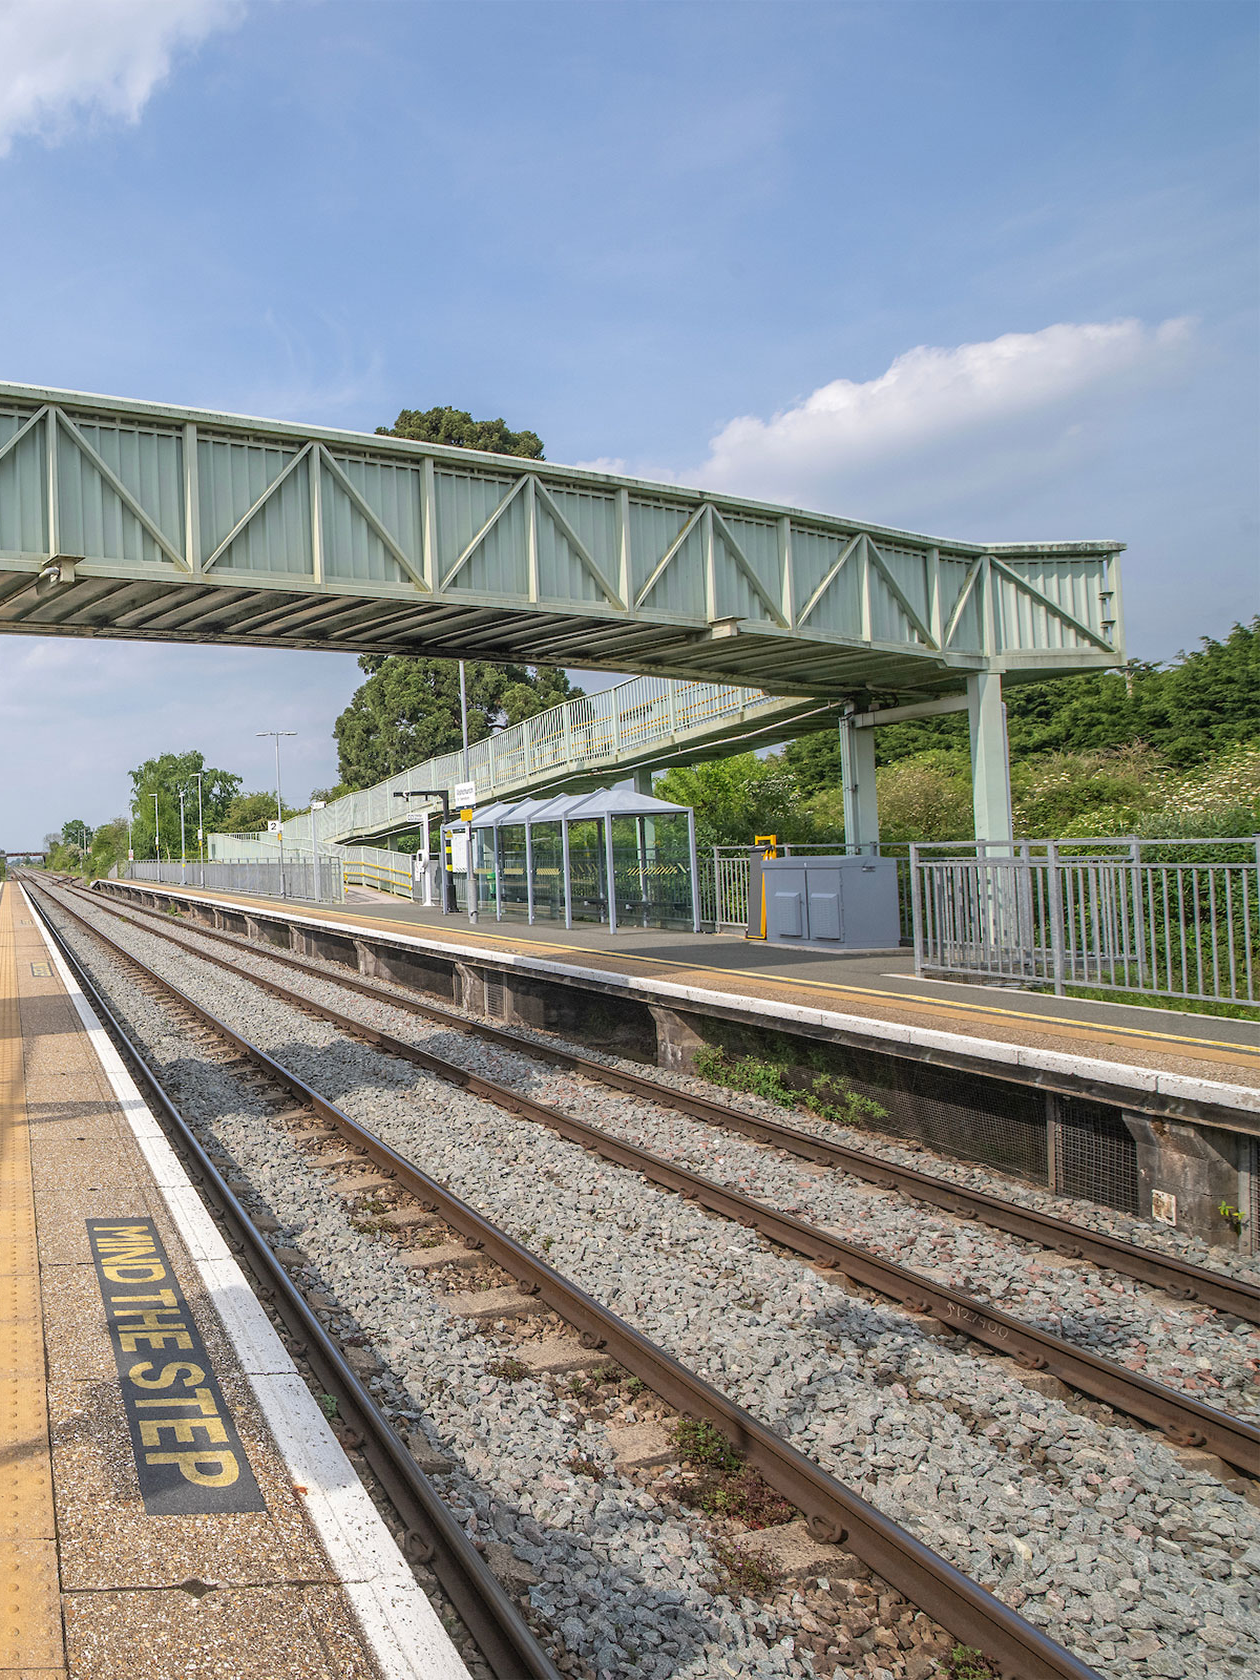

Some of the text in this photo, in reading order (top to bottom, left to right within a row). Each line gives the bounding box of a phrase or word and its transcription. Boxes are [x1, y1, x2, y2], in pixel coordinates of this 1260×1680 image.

[270, 822, 277, 831] 2
[93, 1225, 240, 1488] MIND THE STEP
